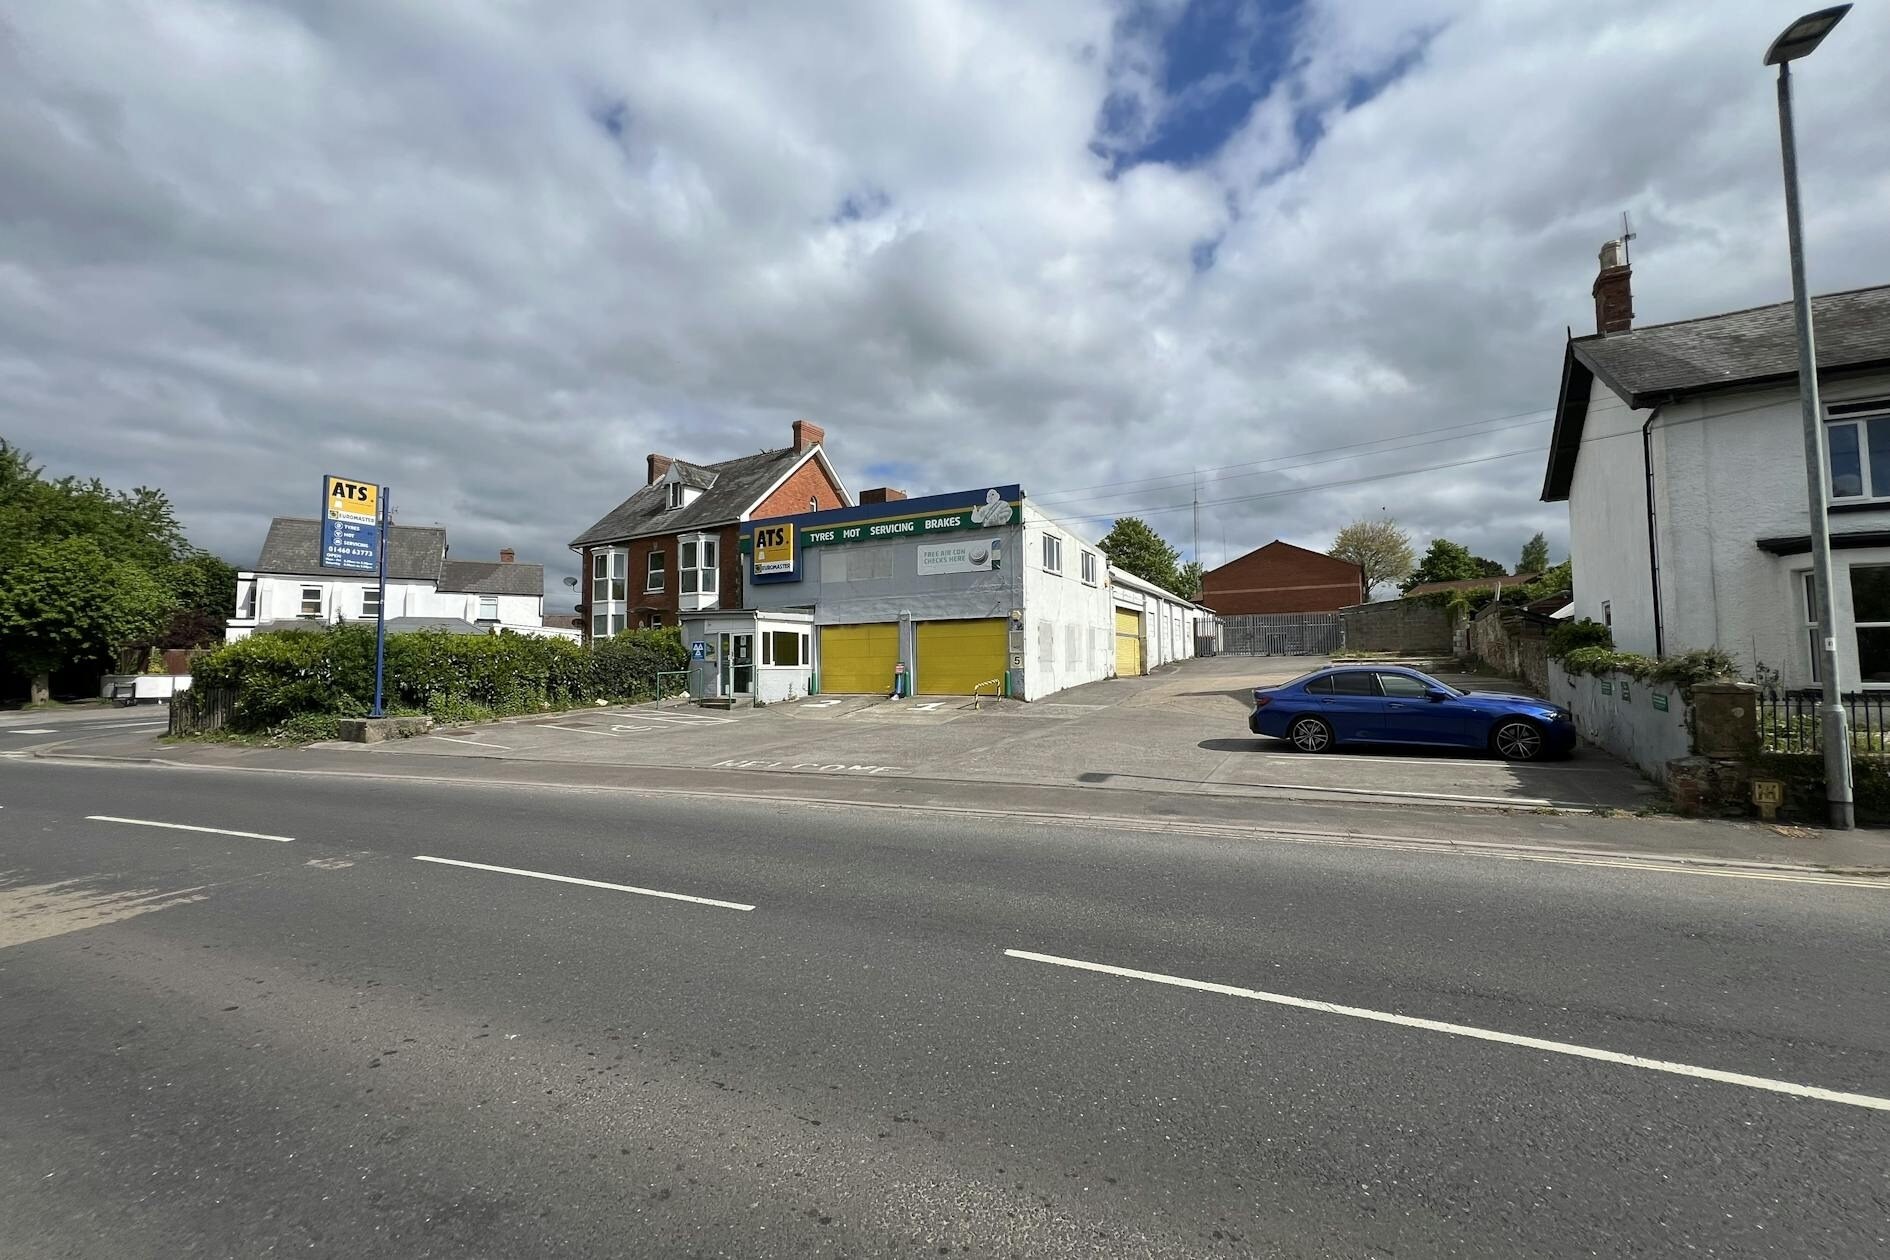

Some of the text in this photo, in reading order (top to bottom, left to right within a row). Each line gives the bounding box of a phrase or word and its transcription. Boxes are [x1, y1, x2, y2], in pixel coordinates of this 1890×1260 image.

[332, 482, 368, 502] ATS
[339, 513, 374, 523] EUROMASTER
[810, 517, 961, 543] TYRES MOT SERVICING BRAKES
[756, 527, 784, 548] ATS
[343, 540, 369, 548] SERVICING
[328, 545, 350, 554] 01460
[924, 555, 965, 564] CHECKS HERE
[762, 563, 791, 571] EUROMASTER
[1014, 656, 1021, 665] 5
